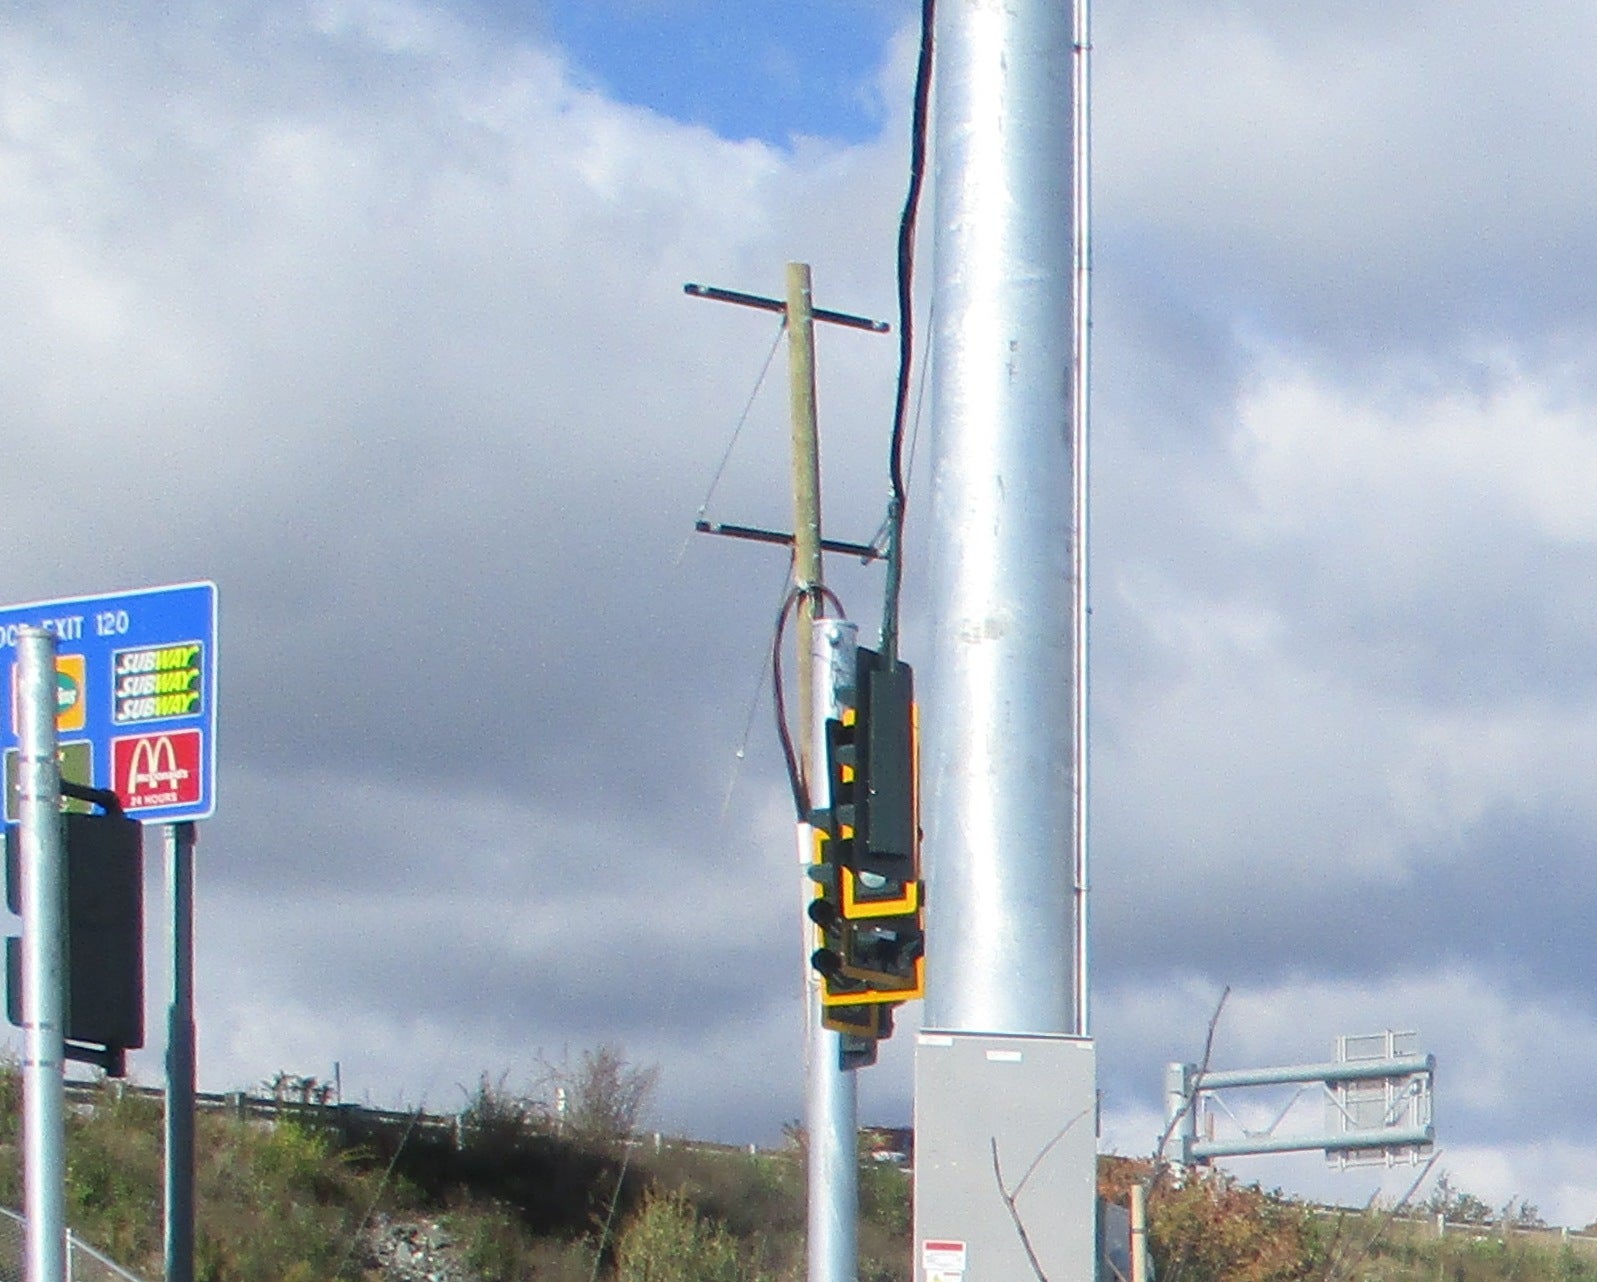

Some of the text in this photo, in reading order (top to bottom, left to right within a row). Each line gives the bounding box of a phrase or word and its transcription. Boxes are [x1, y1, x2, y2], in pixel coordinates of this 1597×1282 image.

[97, 611, 130, 636] 120
[117, 645, 199, 674] SUBWAY
[117, 669, 199, 697] SUBWAY
[117, 691, 199, 720] SUBWAY
